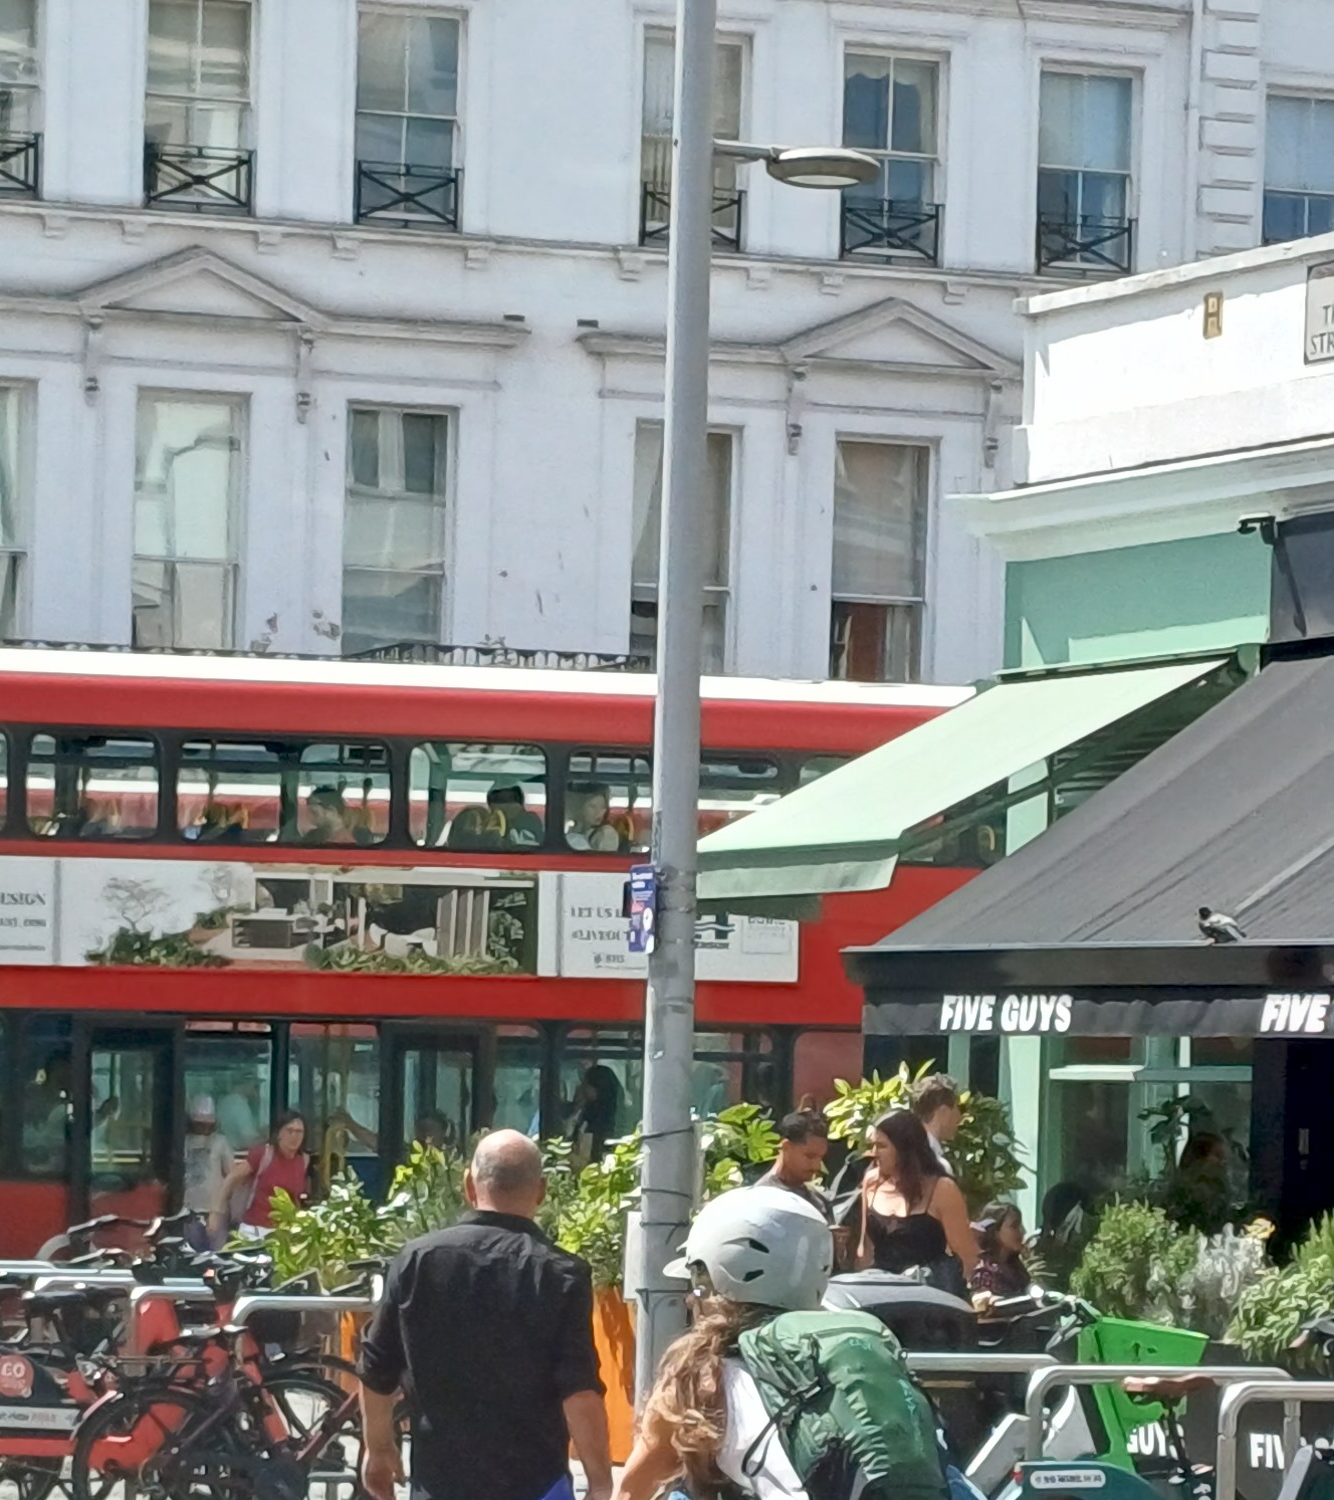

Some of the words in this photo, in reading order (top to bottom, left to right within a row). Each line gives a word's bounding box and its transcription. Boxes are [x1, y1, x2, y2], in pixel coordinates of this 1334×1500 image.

[940, 995, 996, 1031] FIVE
[1000, 994, 1073, 1032] GUYS
[1260, 994, 1331, 1032] FIVE
